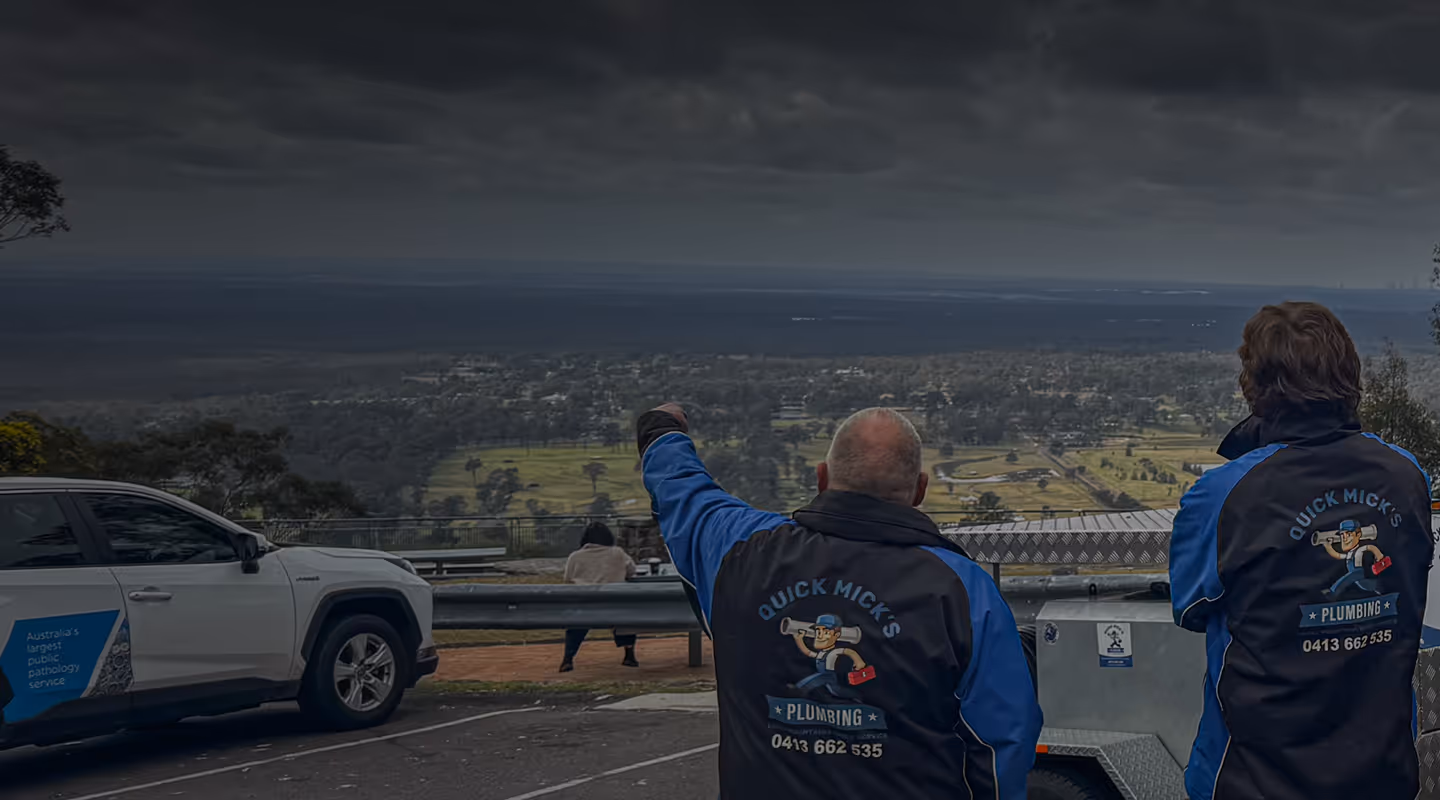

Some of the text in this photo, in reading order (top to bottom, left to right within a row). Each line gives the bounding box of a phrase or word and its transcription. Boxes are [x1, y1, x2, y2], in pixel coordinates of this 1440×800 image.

[1289, 488, 1402, 541] QUICK MICK'S
[758, 577, 901, 639] QUICK MICK'S
[1321, 600, 1381, 623] PLUMBING
[26, 627, 80, 641] Australia's
[1302, 629, 1393, 653] 0413 662 535
[27, 641, 62, 654] largest
[27, 654, 60, 667] public
[28, 664, 80, 679] pathology
[28, 677, 65, 689] service
[786, 703, 863, 727] PLUMBING
[771, 733, 883, 758] 0413 662 535
